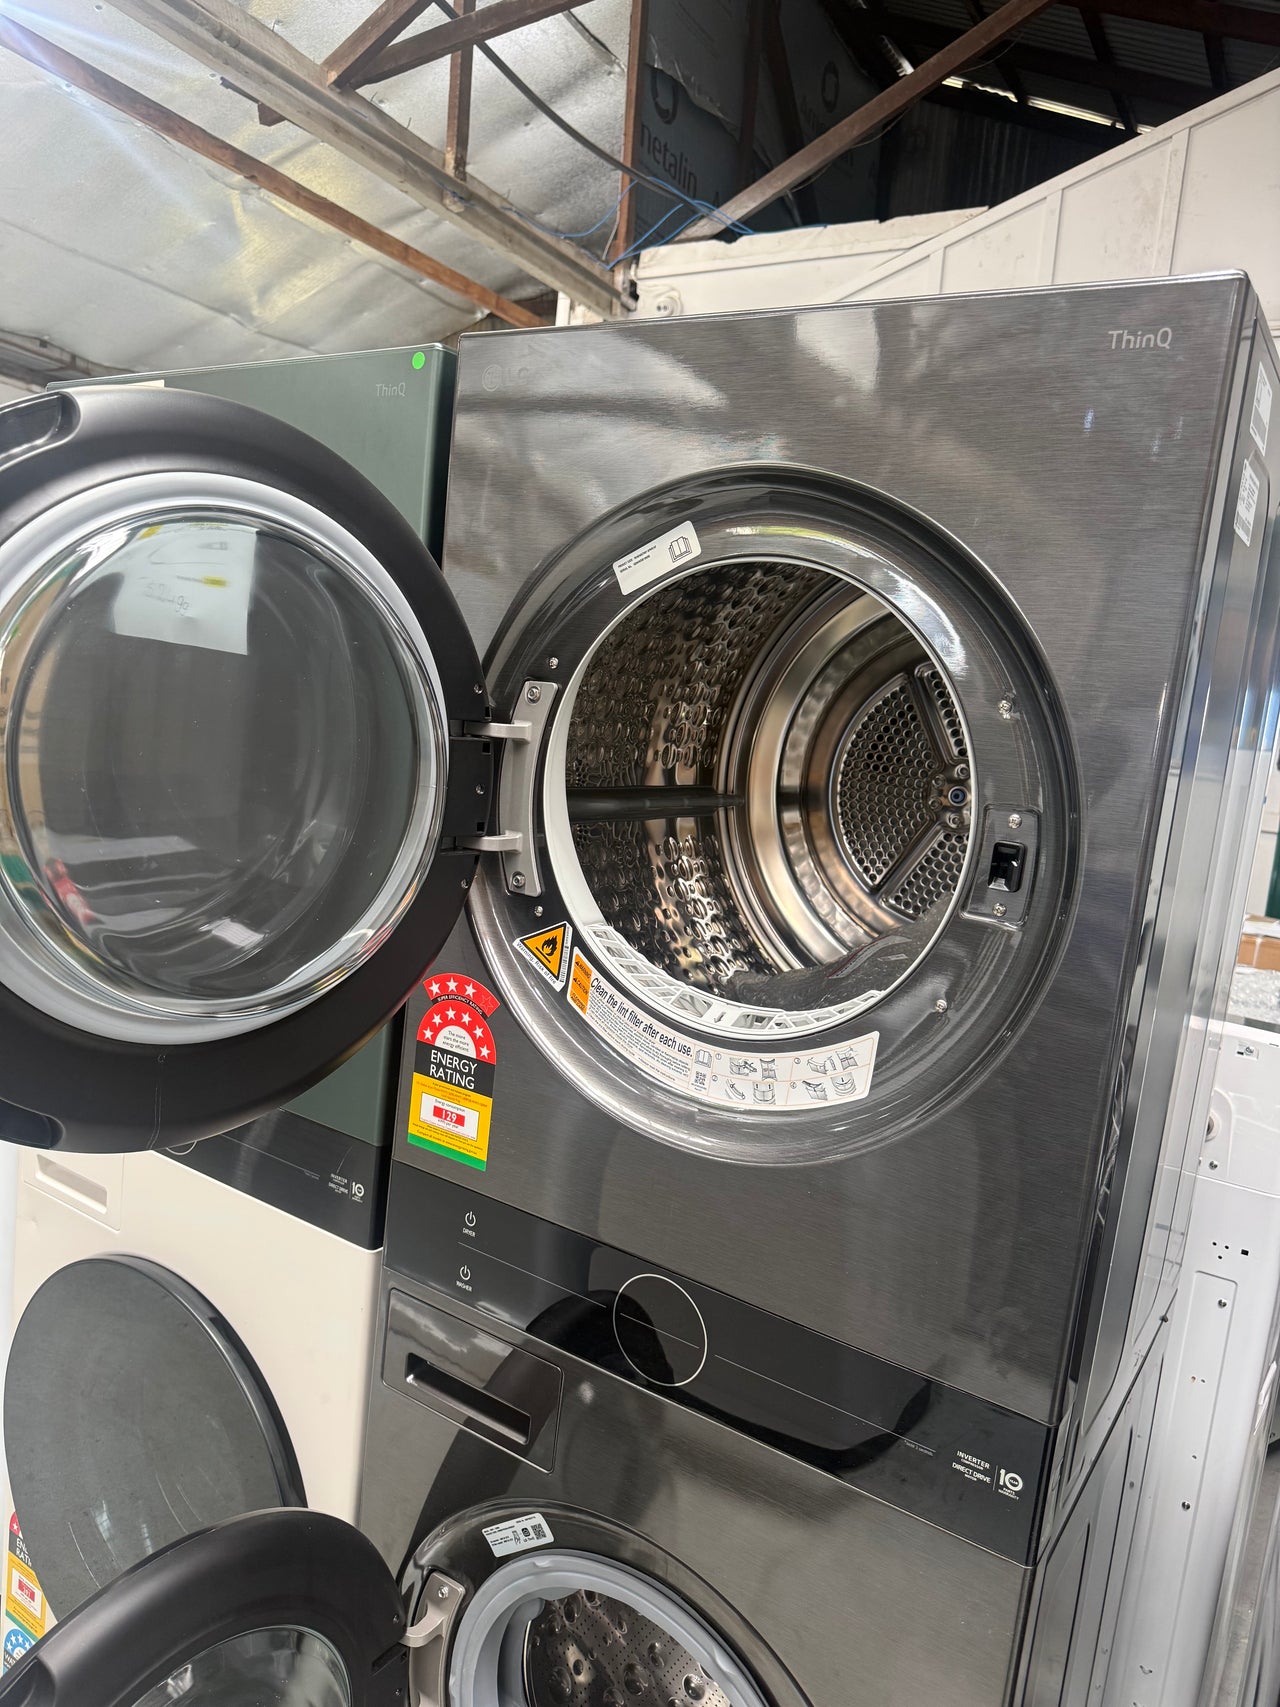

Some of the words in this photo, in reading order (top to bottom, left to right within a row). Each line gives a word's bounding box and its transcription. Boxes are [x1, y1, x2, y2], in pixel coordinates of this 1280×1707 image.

[1108, 327, 1173, 350] ThinQ
[375, 381, 406, 398] ThinQ
[591, 978, 608, 999] Clean
[607, 993, 617, 1009] the
[617, 1001, 629, 1018] lint
[627, 1010, 643, 1029] filter
[643, 1023, 659, 1040] after
[659, 1033, 677, 1050] each
[677, 1043, 693, 1058] use.
[430, 1049, 478, 1076] ENERGY
[429, 1064, 475, 1090] RATING
[442, 1109, 457, 1123] 129
[352, 1181, 365, 1197] 10
[462, 1227, 476, 1238] DRYER
[456, 1280, 472, 1292] WASHER
[957, 1450, 991, 1470] INVERTER
[952, 1462, 973, 1475] DIRECT
[973, 1472, 992, 1484] DRIVE
[999, 1468, 1024, 1492] 10
